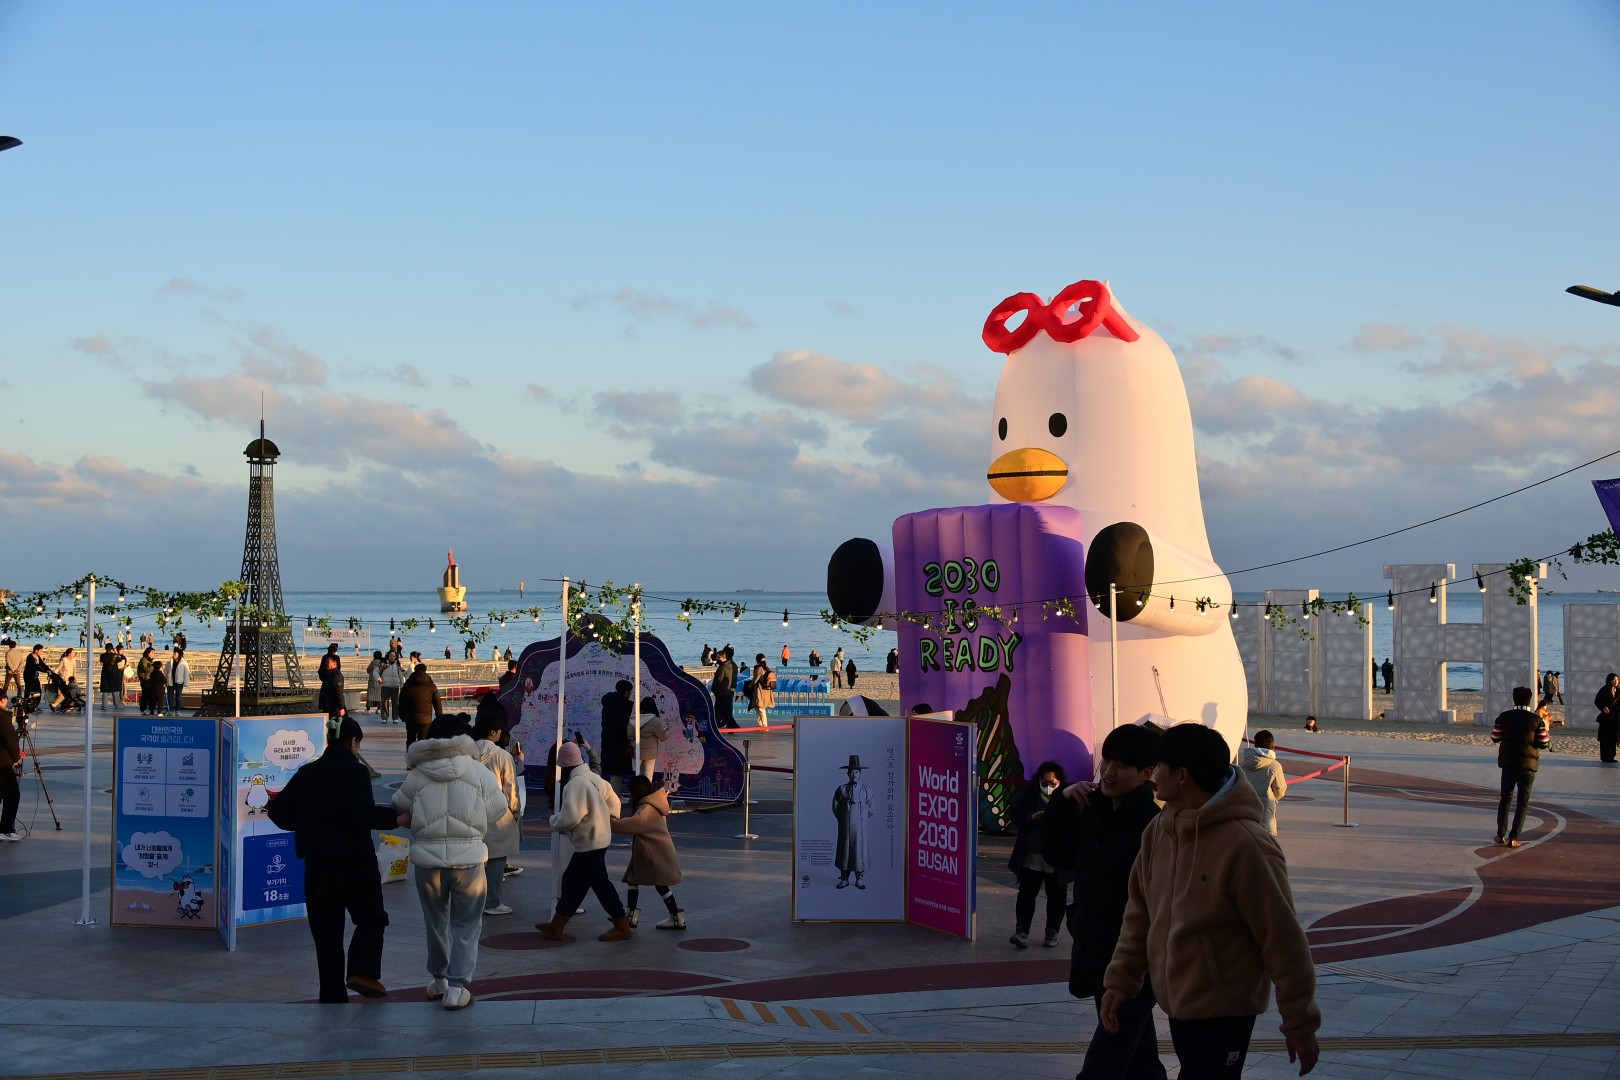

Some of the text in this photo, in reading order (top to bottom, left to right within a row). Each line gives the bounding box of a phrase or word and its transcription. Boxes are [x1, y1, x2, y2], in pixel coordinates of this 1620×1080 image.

[923, 557, 1000, 597] 2030
[944, 598, 979, 634] IS
[920, 632, 1023, 672] READY
[140, 734, 159, 743] 국격이
[151, 726, 183, 734] 대한민국의
[918, 765, 959, 794] World
[918, 792, 959, 822] EXPO
[918, 820, 959, 852] 2030
[918, 849, 958, 876] BUSAN
[263, 889, 290, 902] 18조원
[266, 877, 287, 886] 부가가치
